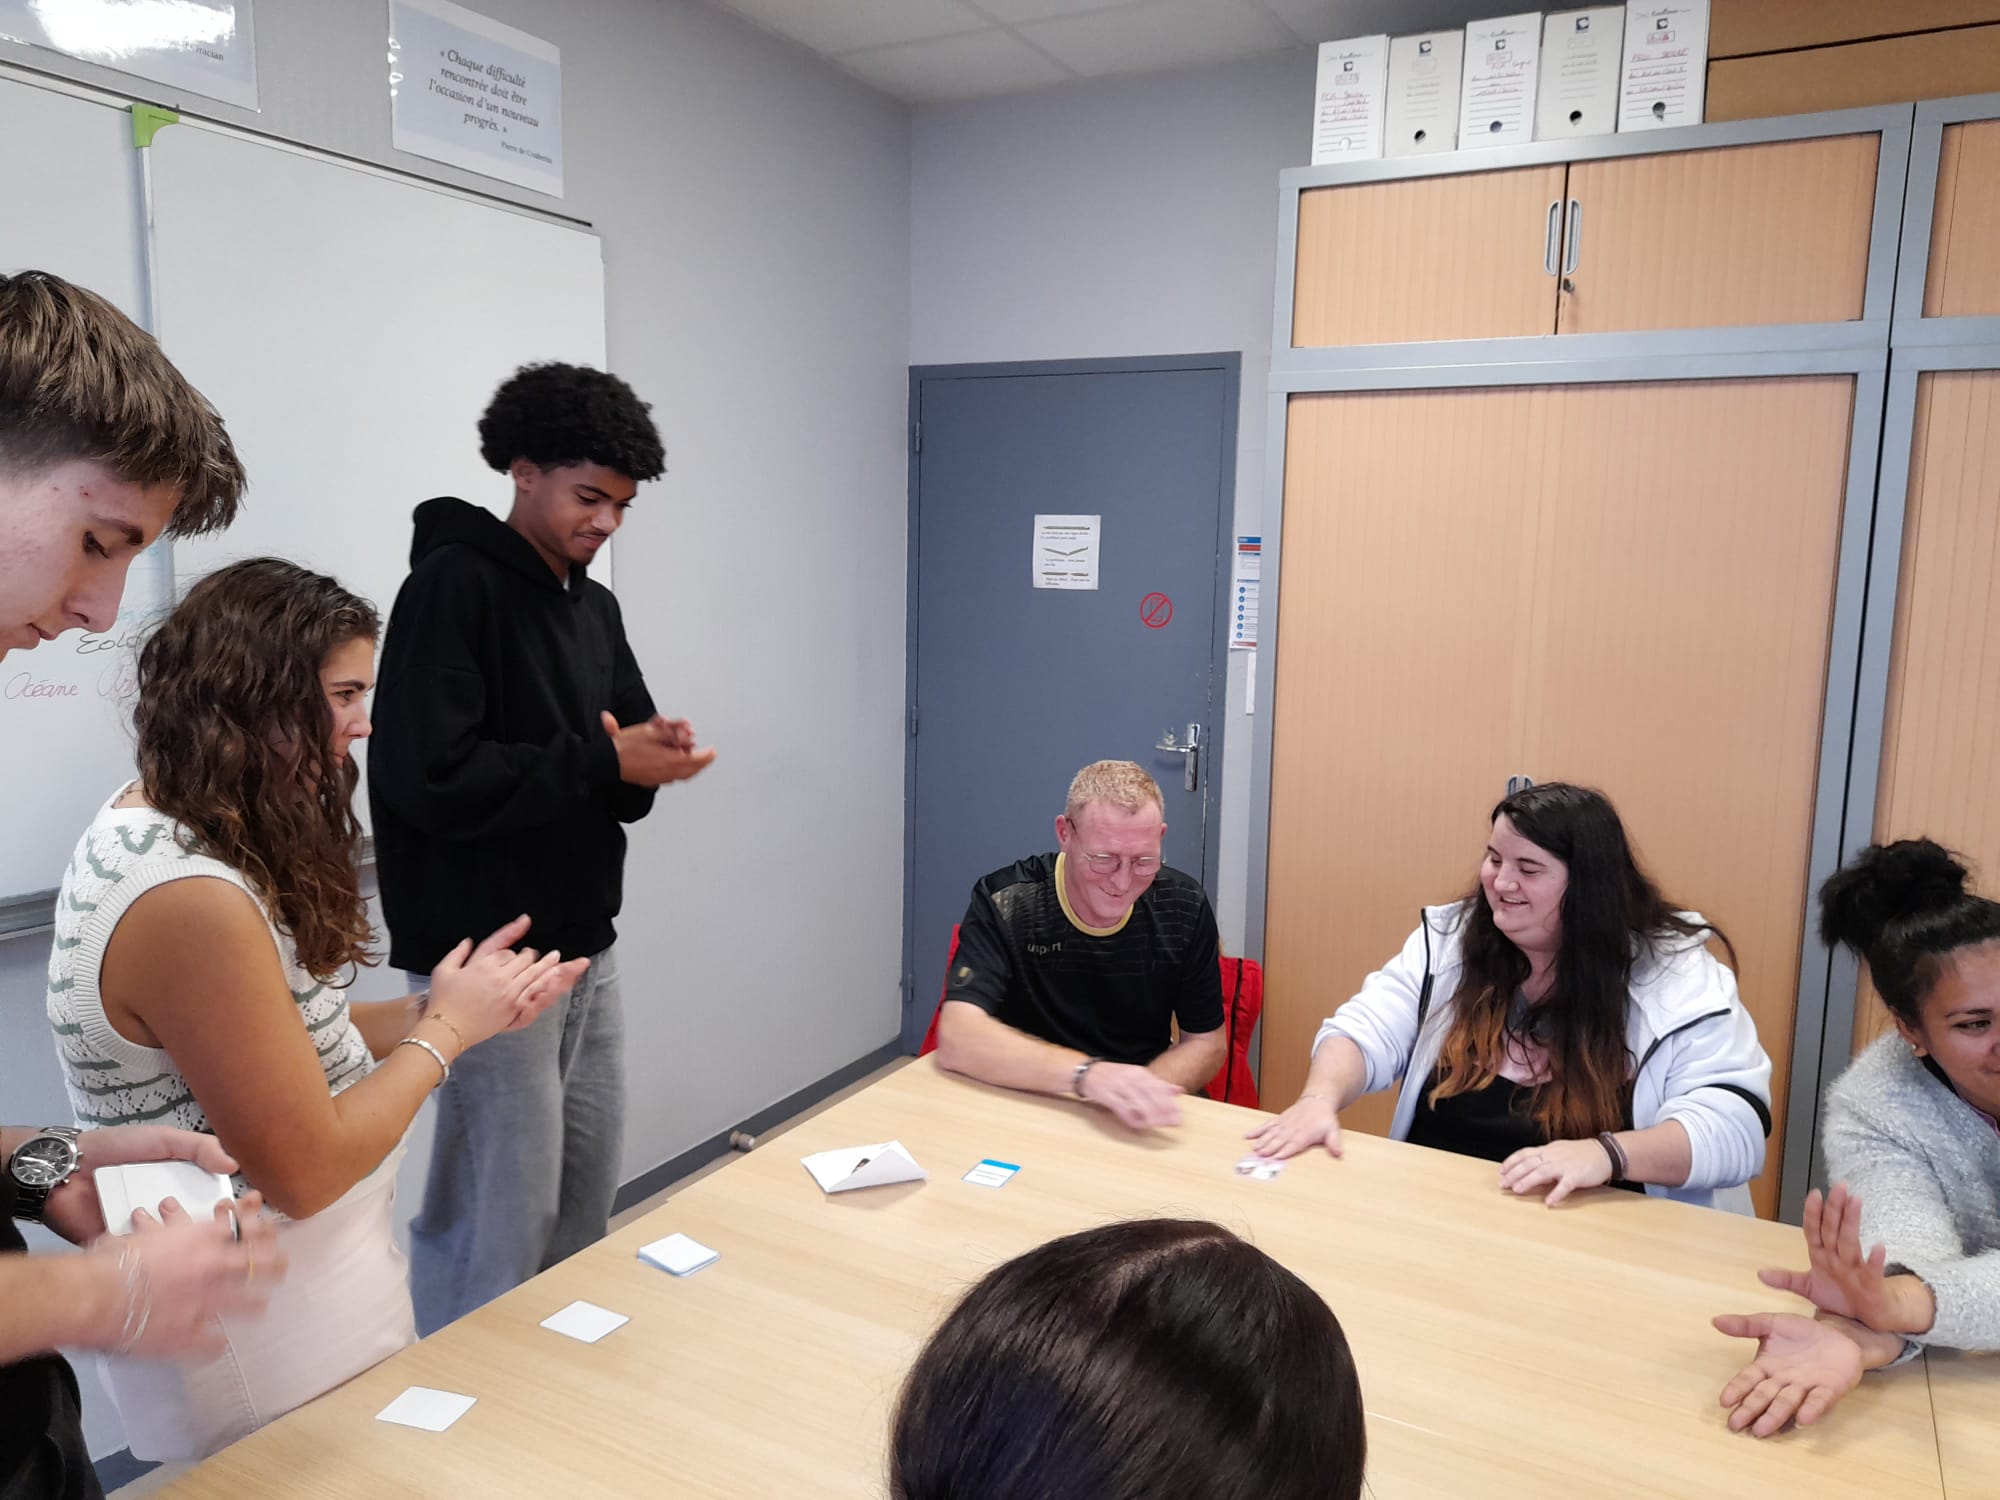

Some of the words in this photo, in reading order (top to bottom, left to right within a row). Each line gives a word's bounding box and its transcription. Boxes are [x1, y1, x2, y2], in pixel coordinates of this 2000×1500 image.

[440, 67, 488, 92] rencontrée
[490, 84, 509, 99] doit
[511, 90, 528, 106] être
[447, 49, 484, 72] Chaque
[486, 64, 527, 88] difficulté
[429, 78, 475, 106] l'occasion
[476, 96, 499, 114] d'un
[501, 107, 539, 128] nouveau
[5, 671, 79, 699] Océane
